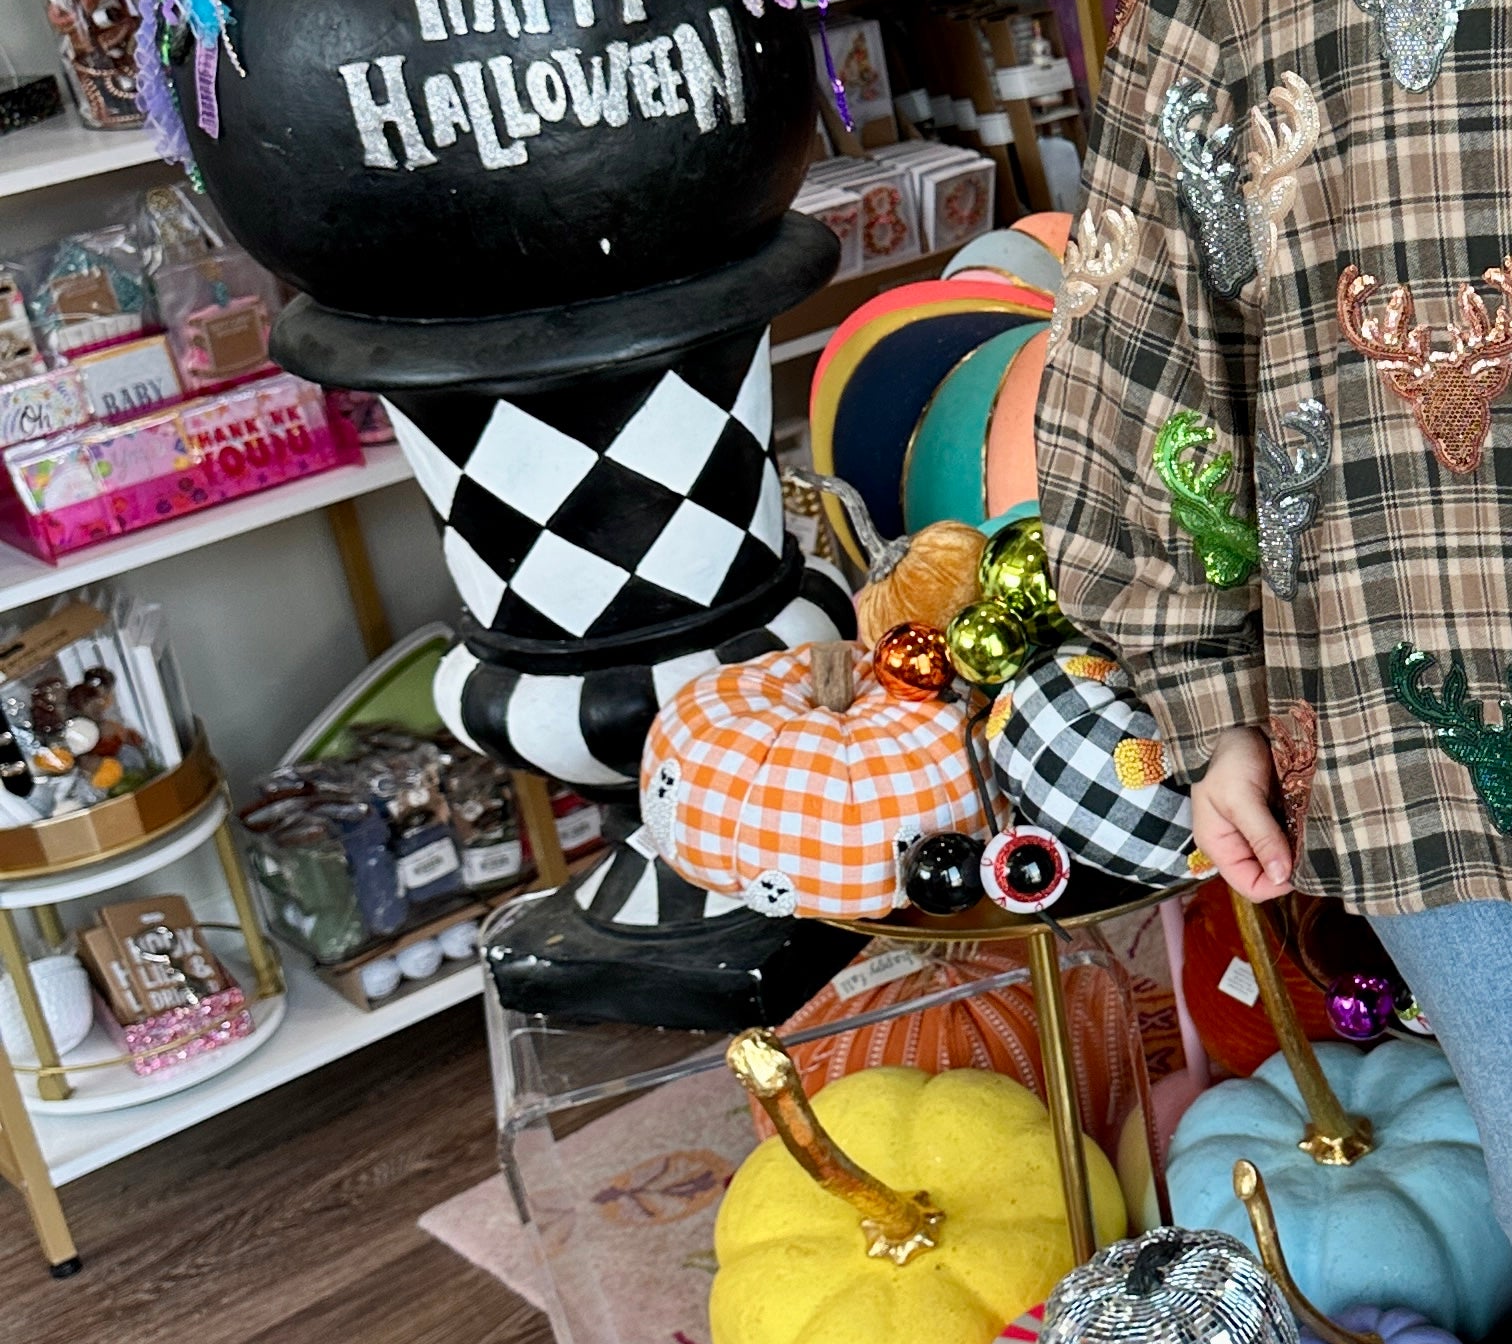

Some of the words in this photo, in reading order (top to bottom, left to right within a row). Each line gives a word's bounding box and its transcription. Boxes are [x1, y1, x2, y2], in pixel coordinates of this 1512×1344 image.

[339, 7, 747, 172] HALLOWEEN
[102, 377, 165, 416] BABY
[20, 404, 51, 434] Oh
